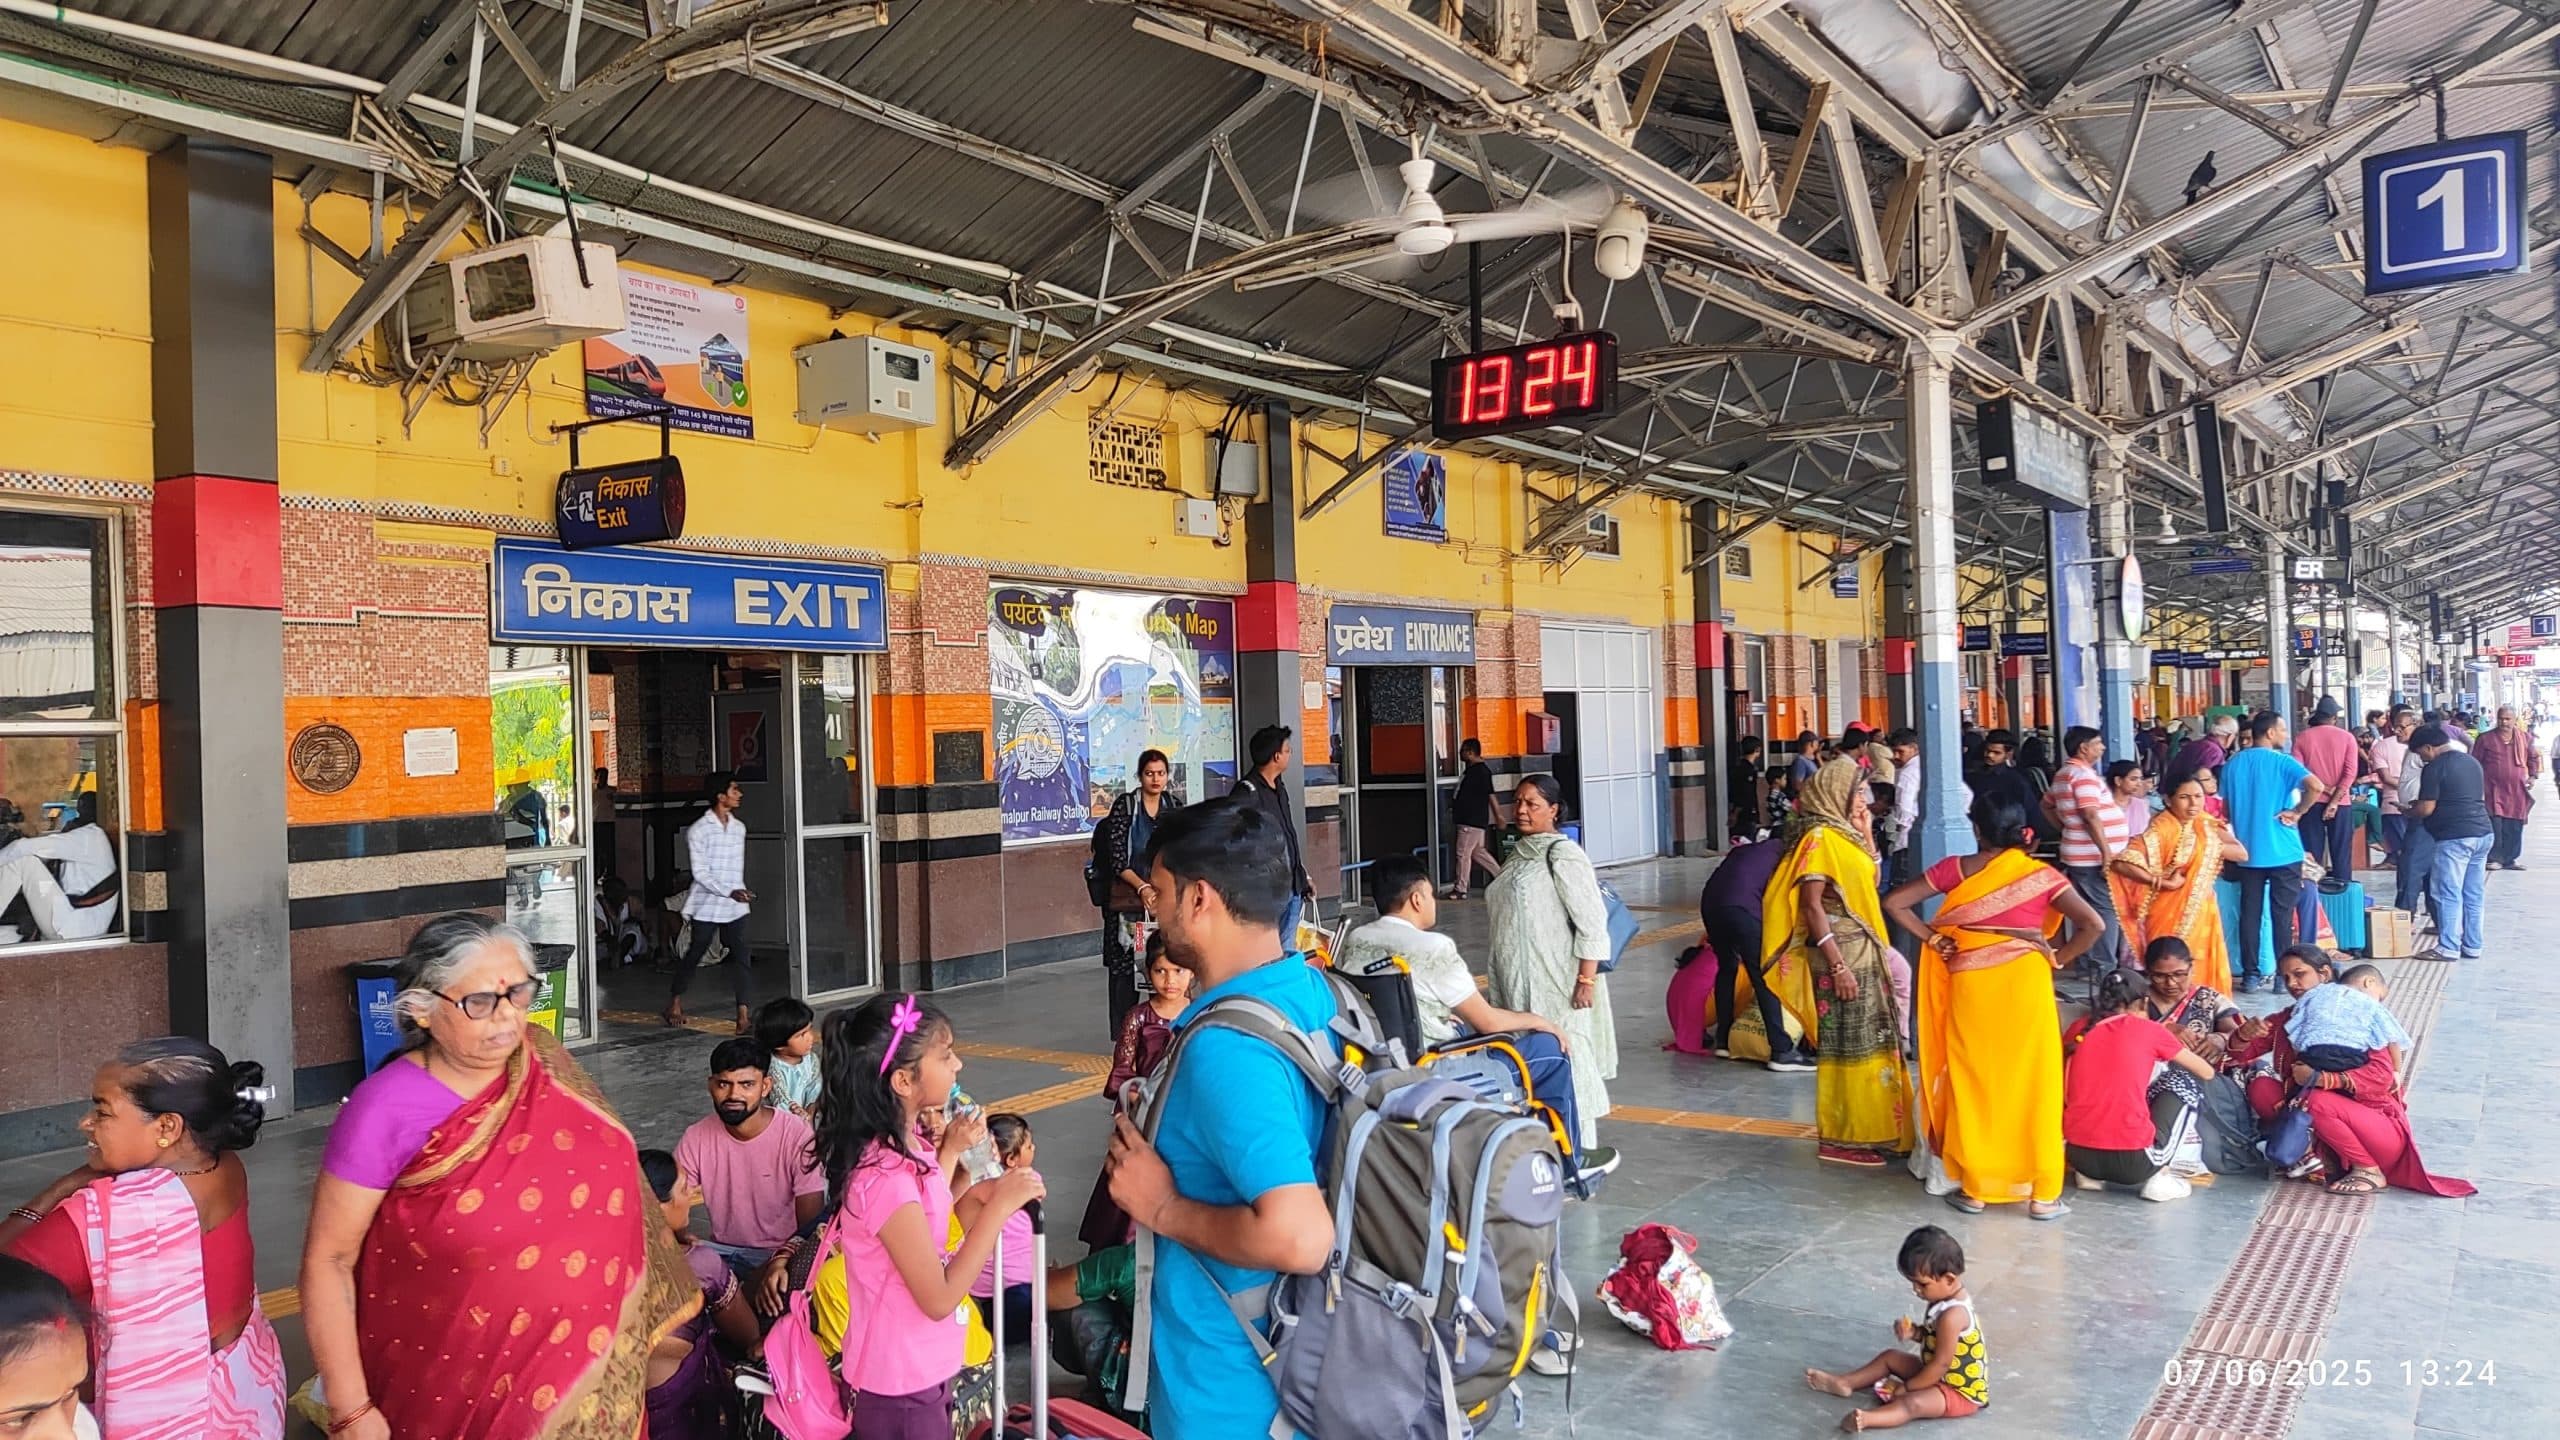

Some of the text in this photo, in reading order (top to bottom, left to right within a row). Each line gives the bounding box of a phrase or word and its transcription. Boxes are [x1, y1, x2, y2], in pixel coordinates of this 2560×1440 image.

[2417, 168, 2464, 251] 1
[691, 411, 701, 419] 145
[597, 475, 653, 503] निकास
[596, 506, 629, 529] Exit
[522, 563, 870, 630] निकास EXIT
[1185, 612, 1218, 640] Map
[1333, 615, 1471, 657] प्रवेश ENTRANCE
[2538, 618, 2548, 633] 1
[1031, 806, 1062, 823] Railway
